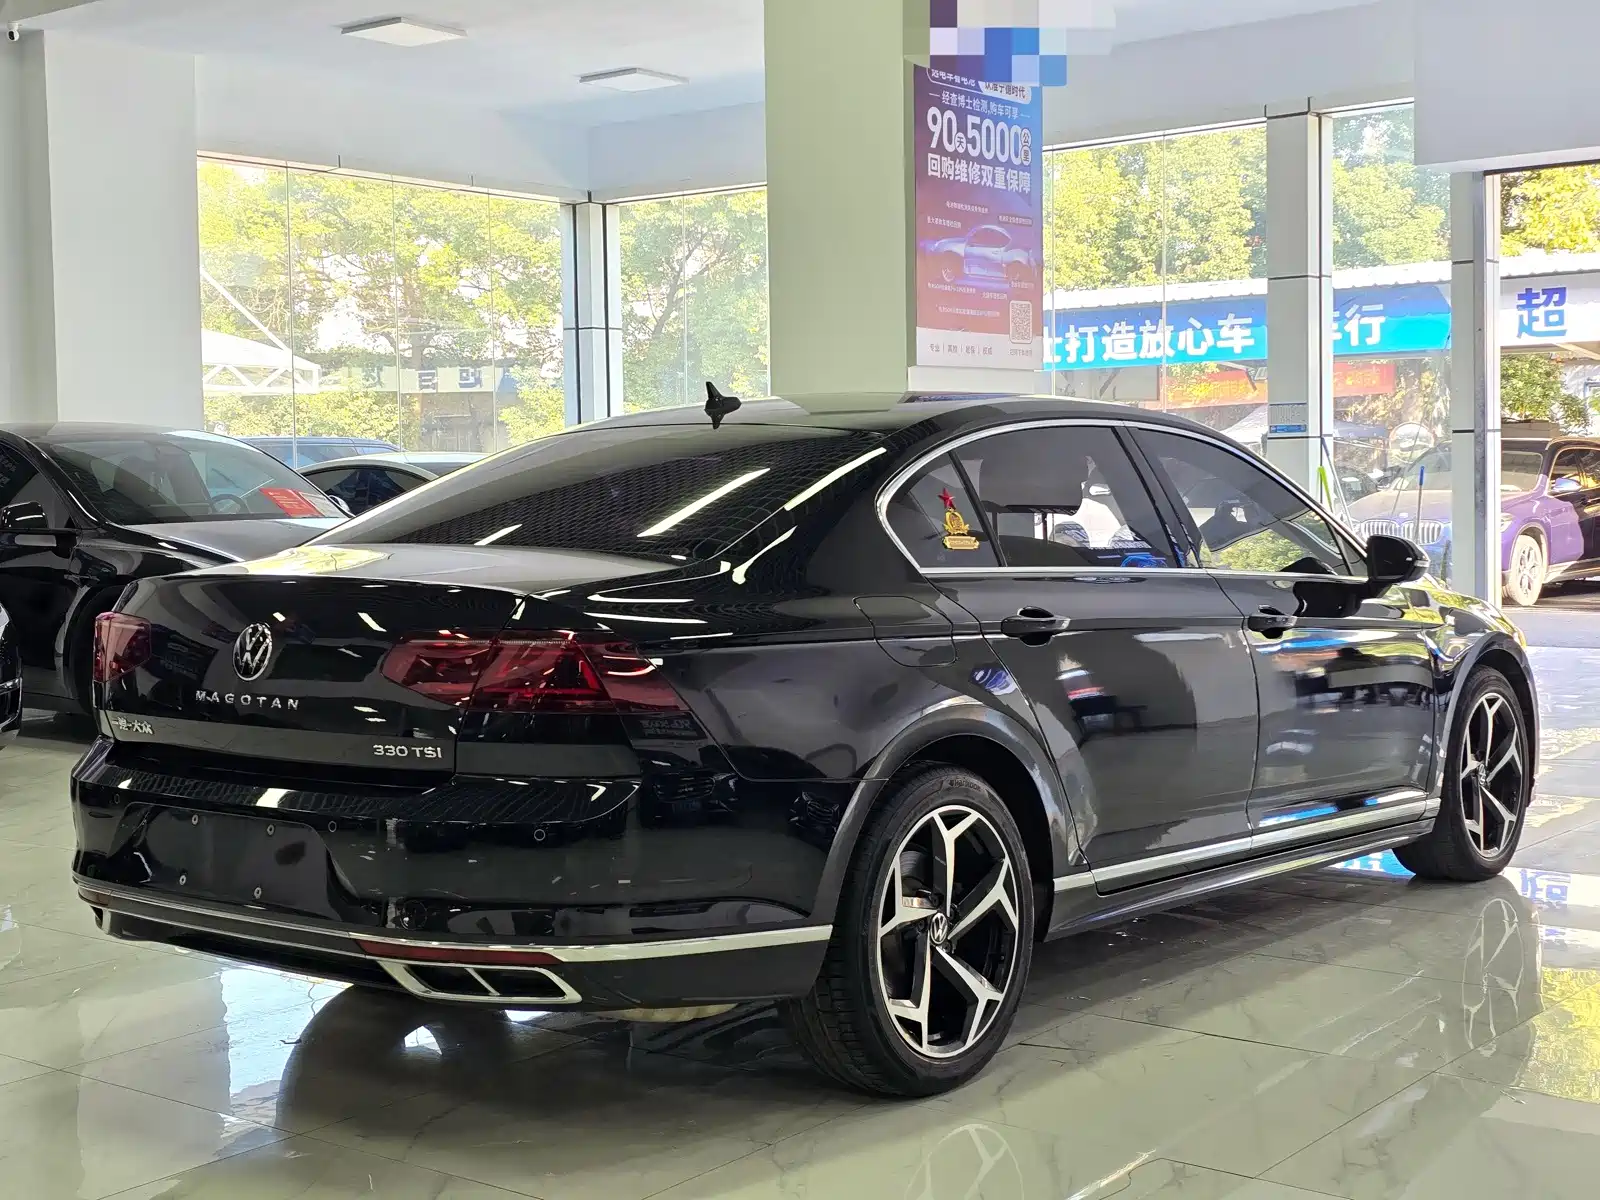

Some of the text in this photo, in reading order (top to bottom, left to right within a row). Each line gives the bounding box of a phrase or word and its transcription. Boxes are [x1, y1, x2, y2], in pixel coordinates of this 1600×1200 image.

[927, 152, 1031, 194] 回购维修双重保障
[1332, 303, 1387, 347] 行
[1516, 286, 1568, 339] 超
[195, 690, 299, 711] MAGOTAN
[373, 744, 442, 758] 330 TSI
